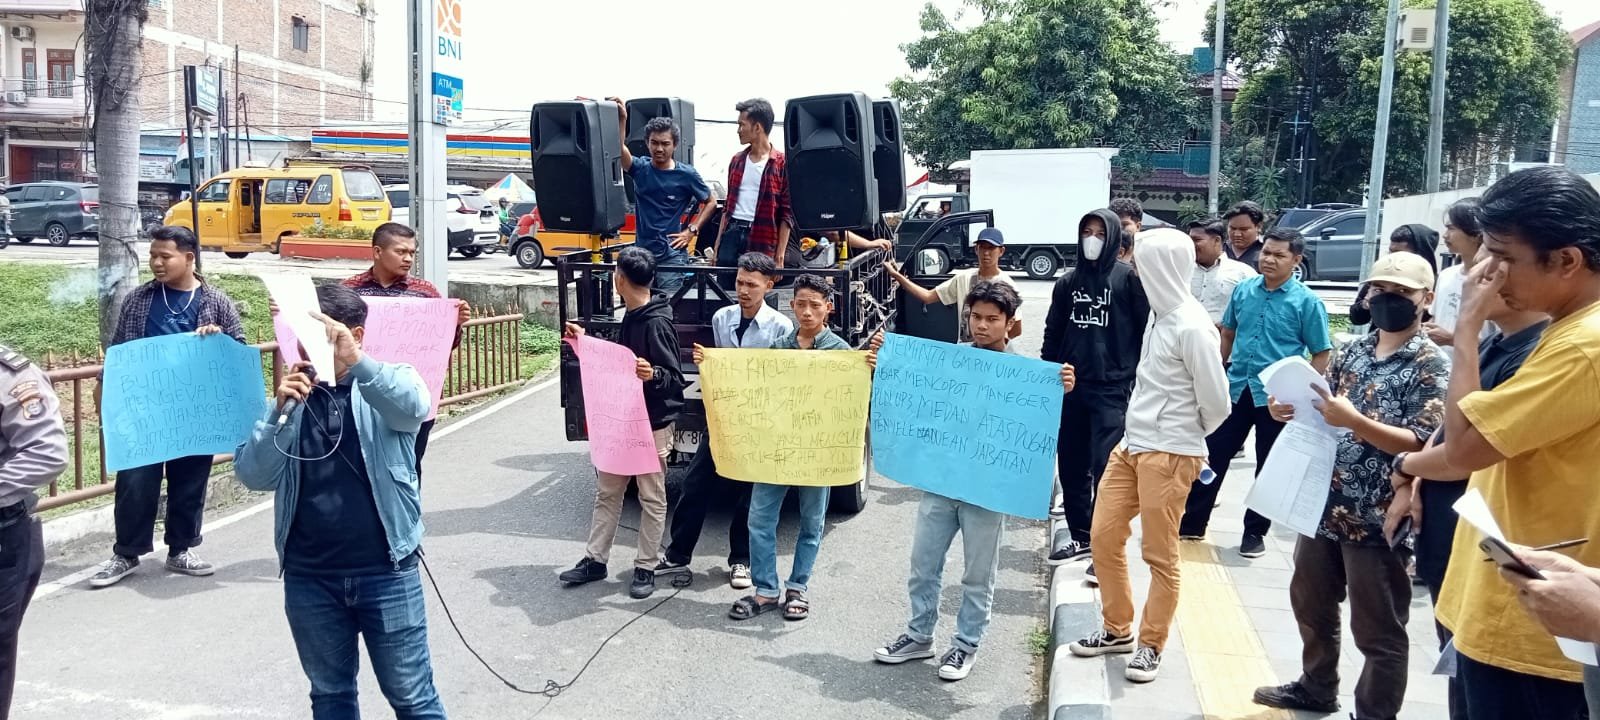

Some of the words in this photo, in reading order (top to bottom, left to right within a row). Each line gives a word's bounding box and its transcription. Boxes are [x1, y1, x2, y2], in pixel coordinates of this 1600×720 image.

[438, 36, 462, 60] BNI
[438, 78, 452, 89] ATM
[1069, 307, 1109, 329] الطيبة
[884, 336, 945, 369] MEMINTA
[952, 350, 971, 371] GM
[119, 366, 193, 393] BUMN
[904, 370, 970, 398] MENCOPOT
[977, 384, 1052, 416] MANEGER
[916, 395, 970, 424] MEDAN
[969, 437, 1033, 474] JABATAN
